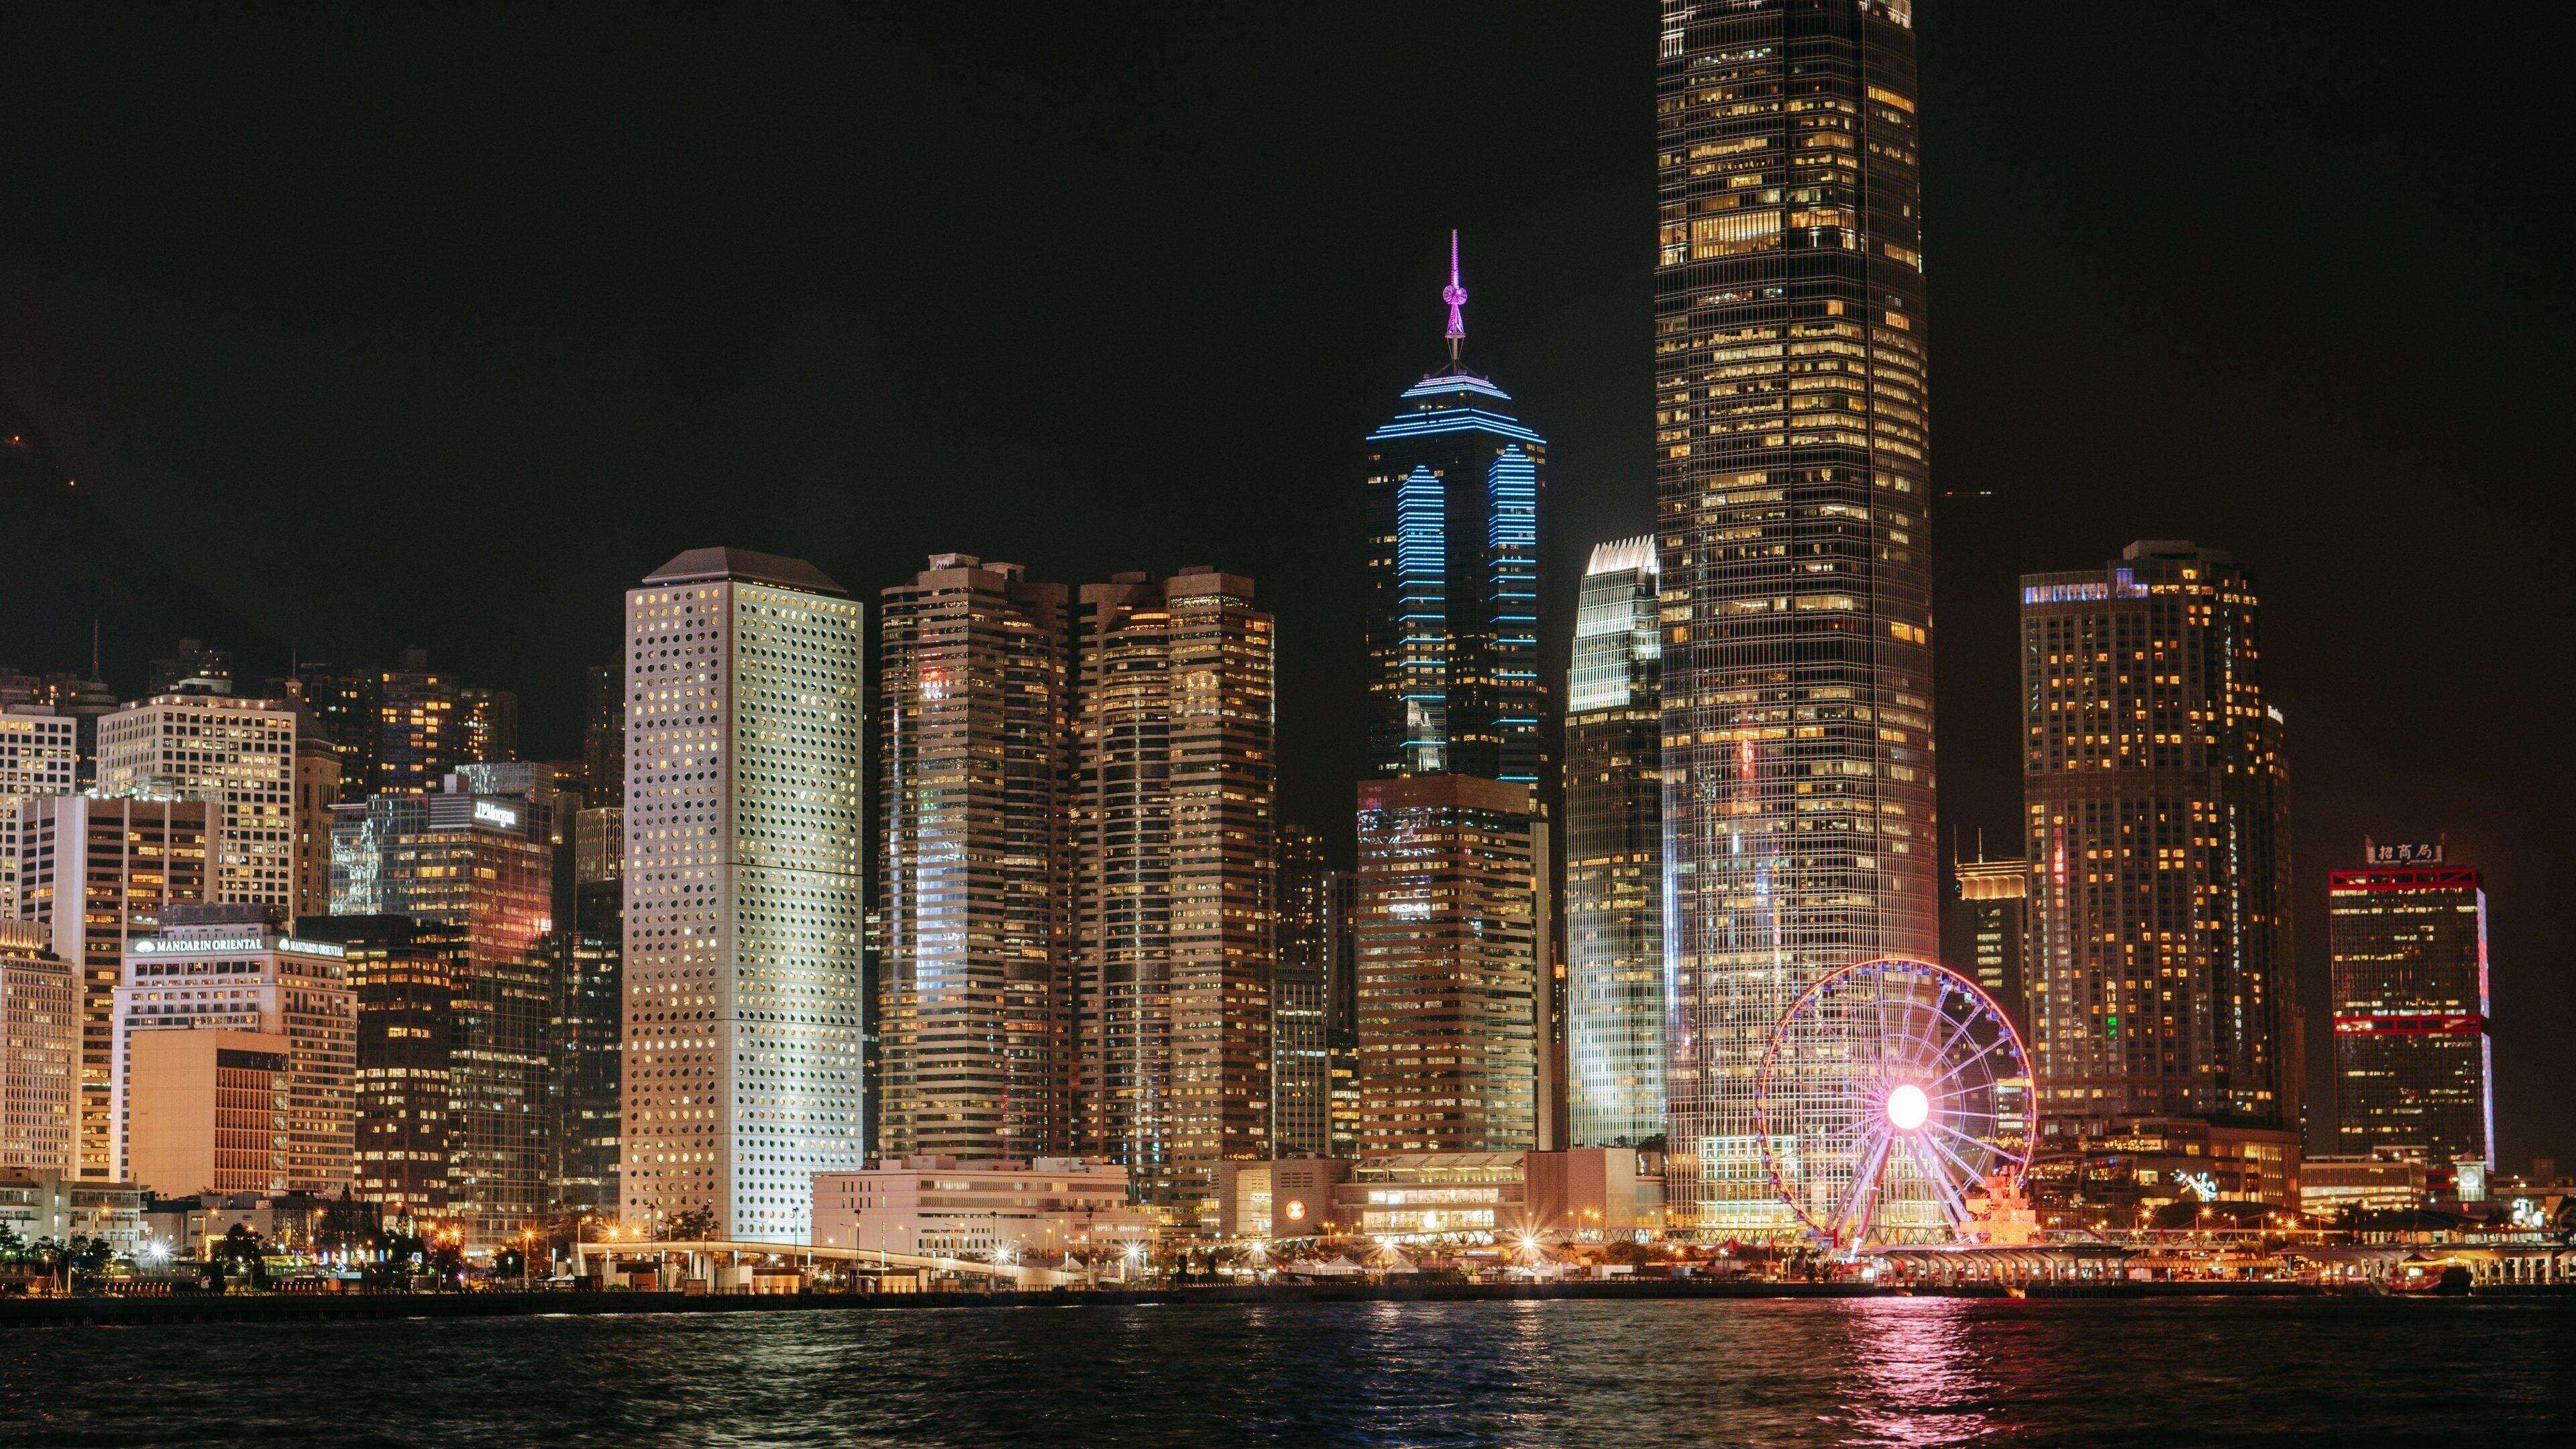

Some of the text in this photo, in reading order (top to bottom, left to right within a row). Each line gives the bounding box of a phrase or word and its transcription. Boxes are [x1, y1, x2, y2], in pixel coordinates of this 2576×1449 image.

[2377, 844, 2432, 859] 招商局
[156, 938, 262, 952] MANDARIN ORIENTAL
[290, 941, 344, 957] MANDARIN ORIENTAL
